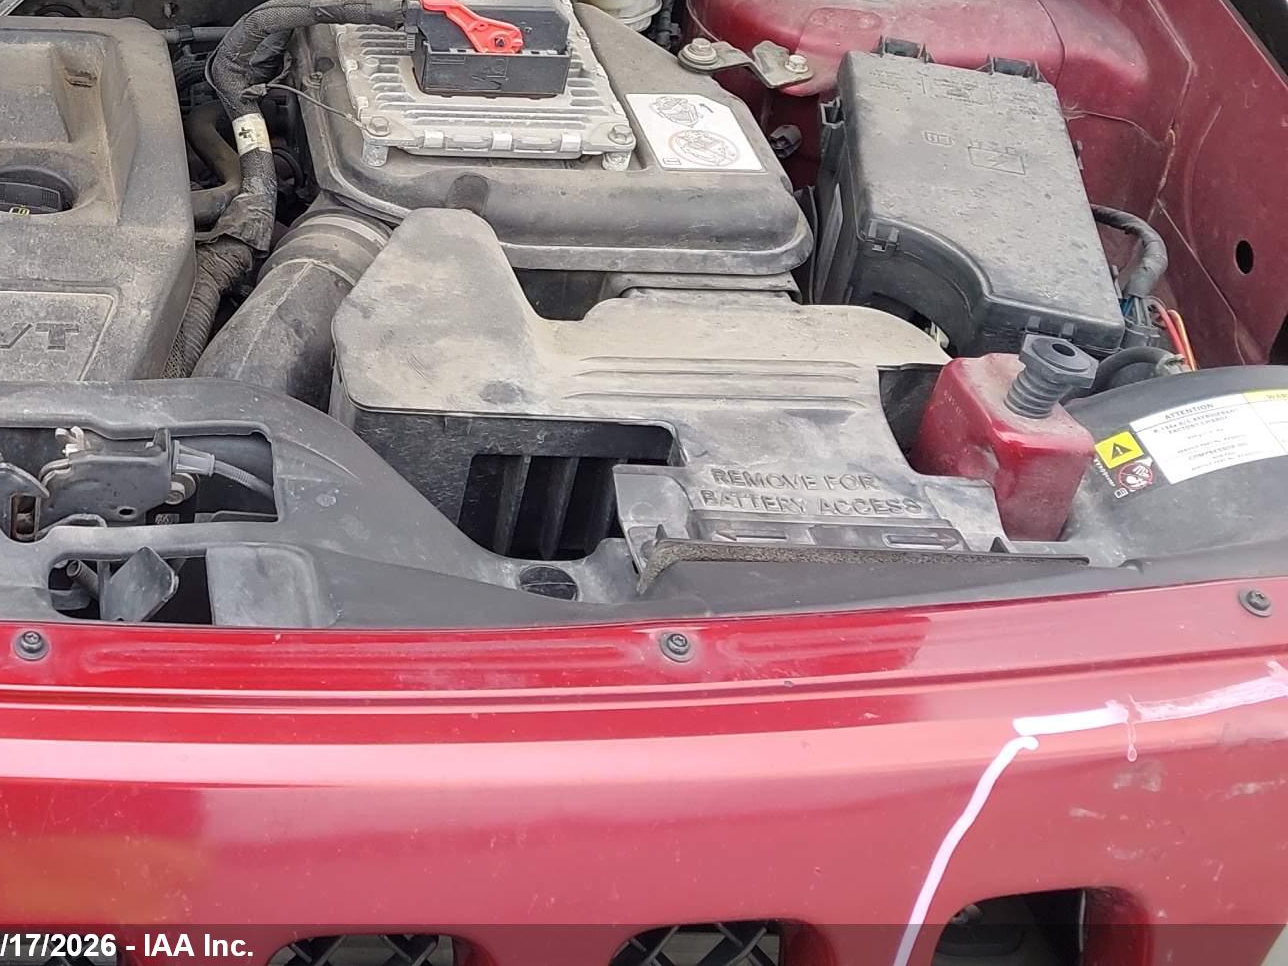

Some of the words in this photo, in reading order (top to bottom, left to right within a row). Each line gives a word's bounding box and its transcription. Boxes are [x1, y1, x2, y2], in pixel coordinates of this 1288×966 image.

[1164, 403, 1214, 420] ATTENTION
[711, 467, 818, 492] REMOVE
[823, 473, 883, 492] FOR
[699, 489, 807, 514] BATTERY
[818, 497, 923, 516] ACCESS
